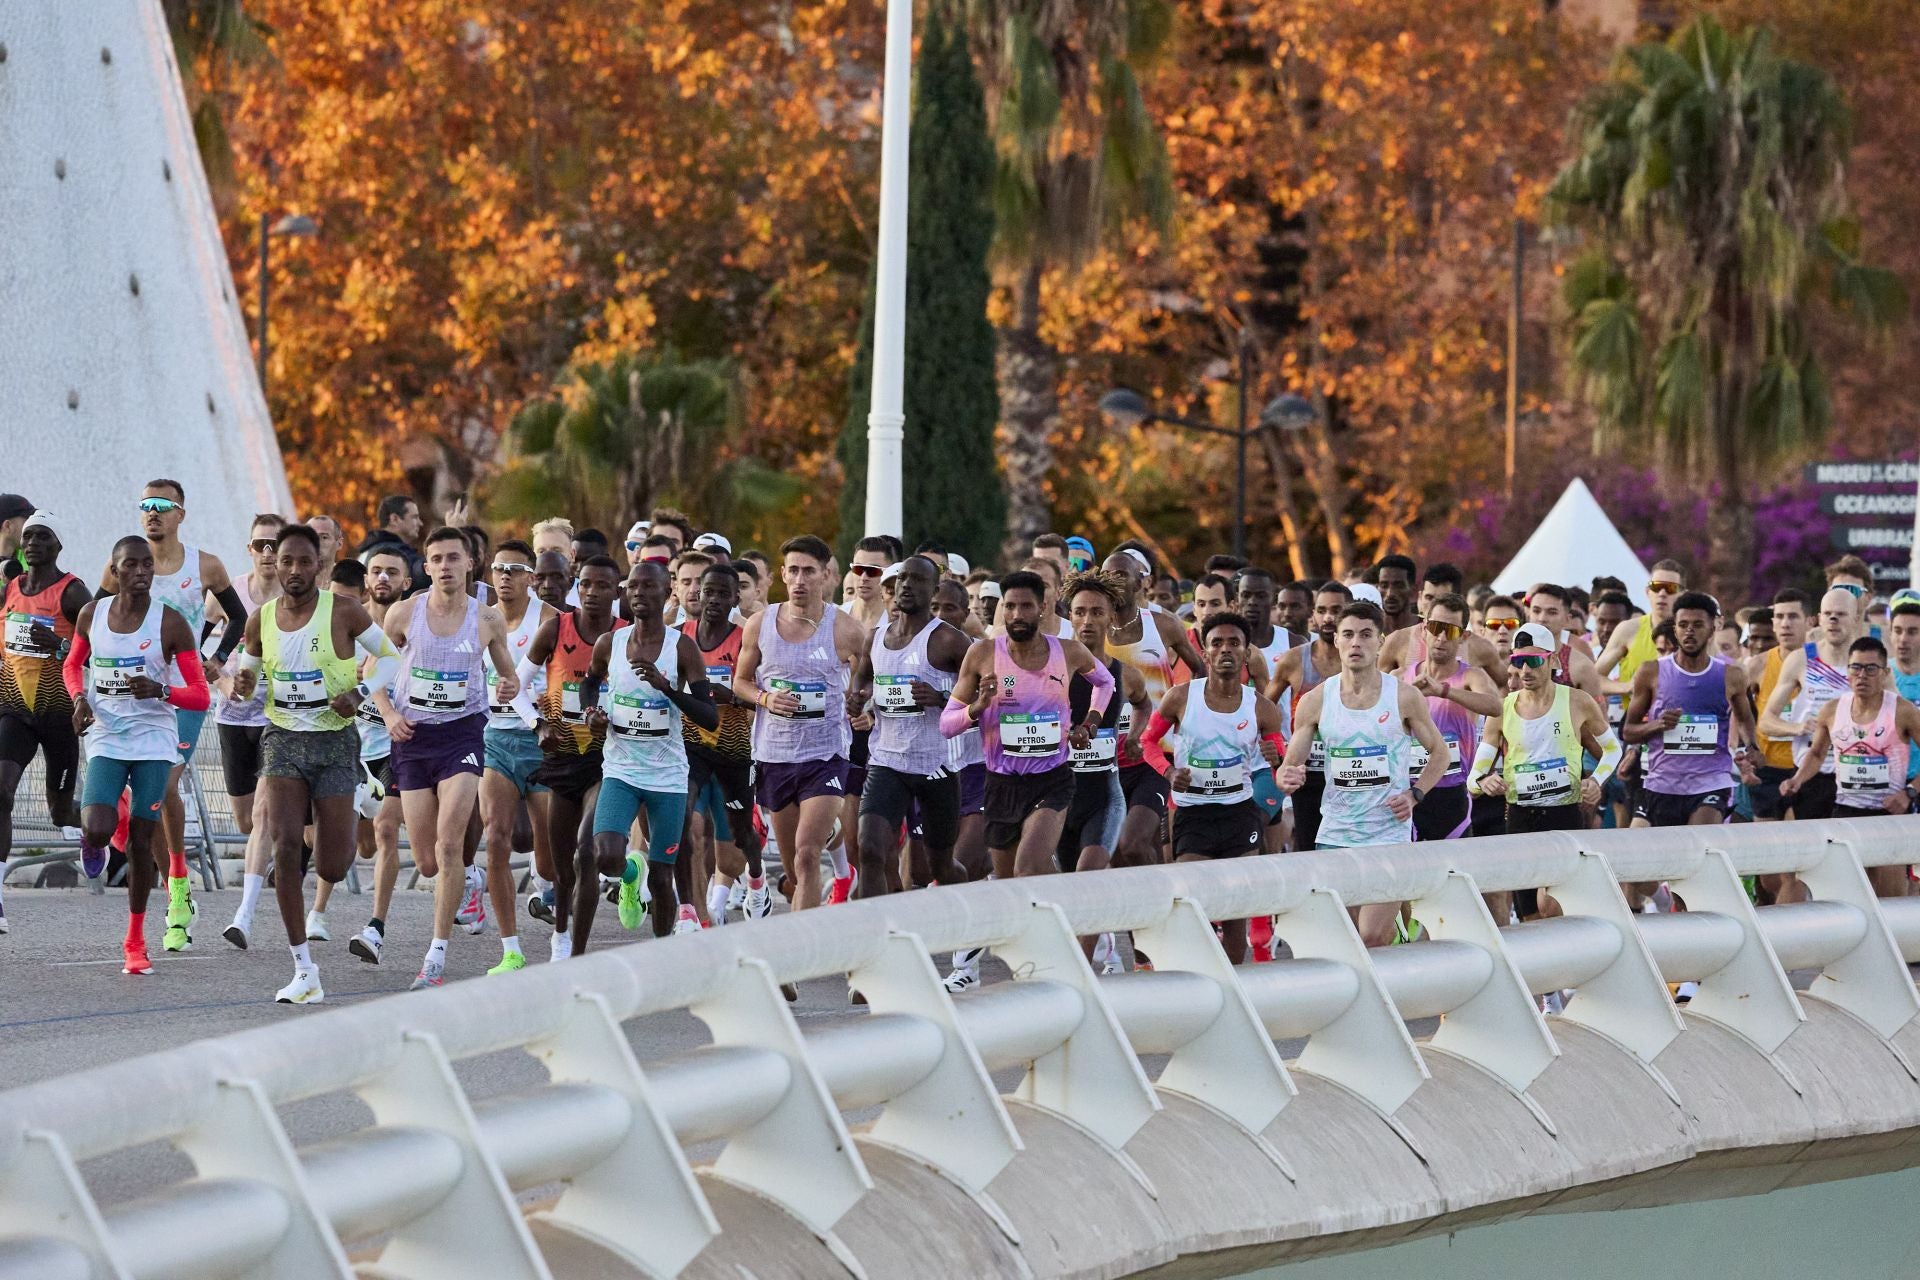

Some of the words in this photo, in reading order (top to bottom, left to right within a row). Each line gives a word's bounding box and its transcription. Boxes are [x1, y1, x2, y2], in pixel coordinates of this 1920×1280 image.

[1817, 464, 1873, 483] MUSEU
[15, 635, 33, 644] PACE
[113, 669, 120, 678] 6
[291, 683, 298, 692] 9
[432, 683, 444, 691] 25
[887, 687, 902, 696] 388
[427, 692, 448, 701] MAYO
[885, 697, 906, 705] PACER
[636, 710, 643, 719] 2
[628, 719, 651, 729] KORIR
[1025, 725, 1037, 735] 10
[1685, 725, 1696, 734] 77
[1017, 736, 1046, 745] PETROS
[1680, 735, 1701, 743] Leduc
[1073, 751, 1101, 760] CRIPPA
[1351, 759, 1363, 769] 22
[1212, 770, 1219, 779] 8
[1339, 769, 1379, 779] SESEMANN
[1534, 773, 1546, 782] 16
[1204, 780, 1227, 788] AYALE
[1526, 780, 1558, 792] NAVARRO
